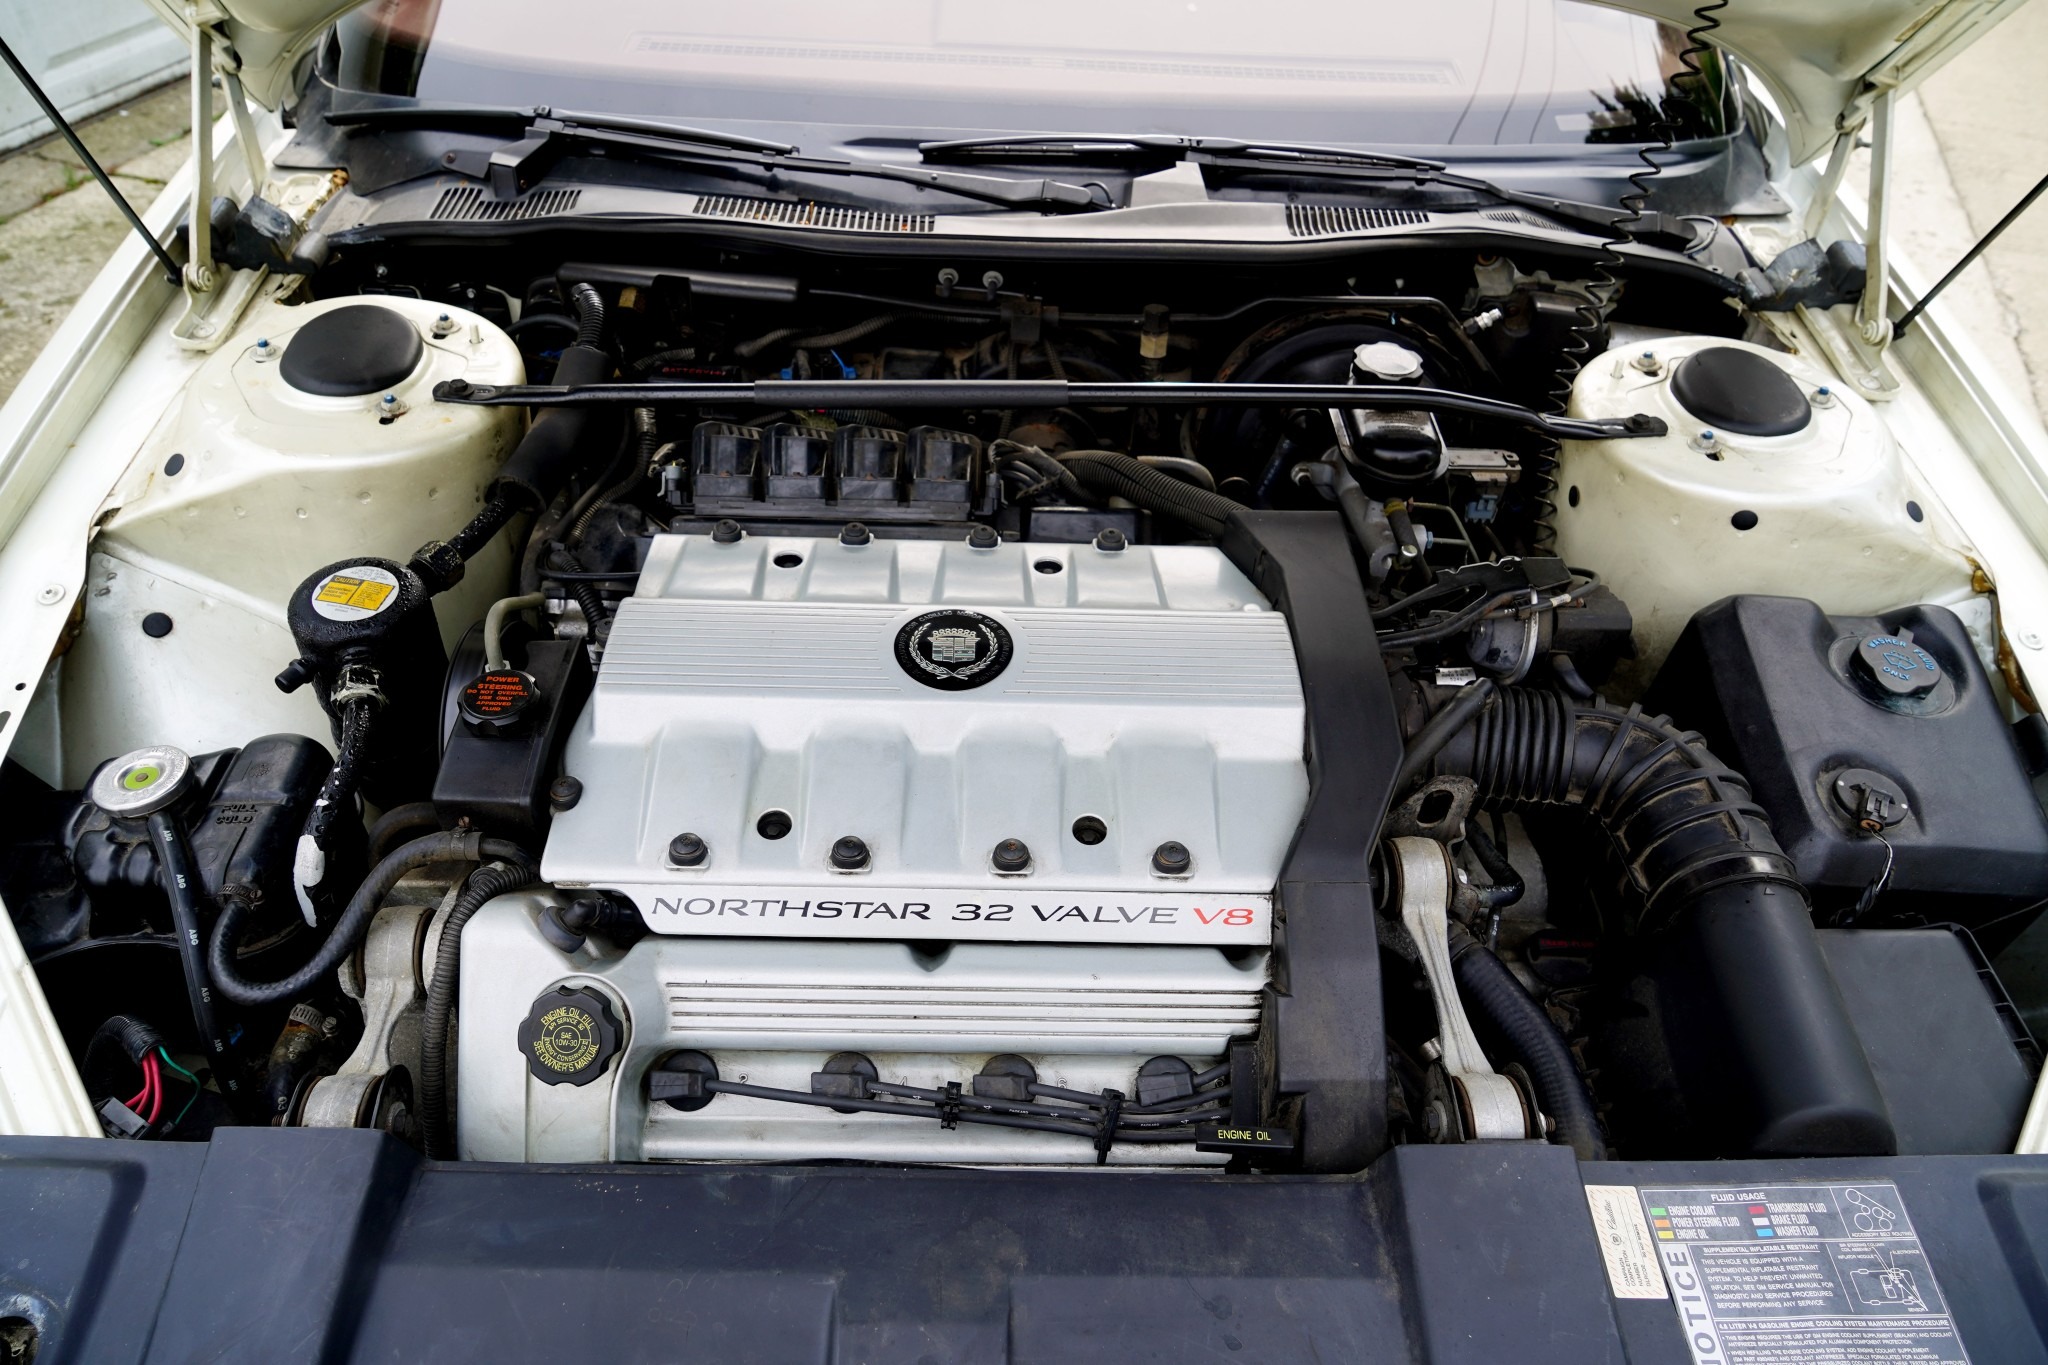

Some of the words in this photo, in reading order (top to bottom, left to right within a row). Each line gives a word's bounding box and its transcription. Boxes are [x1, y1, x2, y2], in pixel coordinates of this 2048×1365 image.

[334, 576, 361, 584] CAUTION
[919, 610, 952, 622] CADILLAC
[957, 610, 982, 620] MOTOR
[984, 618, 998, 628] CAR
[1867, 638, 1906, 648] WASHER
[1913, 648, 1935, 670] FLUID
[1882, 666, 1911, 680] ONLY
[176, 874, 186, 888] ABG
[652, 896, 932, 920] NORTHSTAR
[951, 903, 1014, 922] 32
[1030, 904, 1179, 924] VALVE
[1192, 908, 1254, 926] V8
[188, 929, 199, 945] ABG
[541, 1006, 567, 1025] ENGINE
[569, 1008, 580, 1019] OIL
[581, 1014, 594, 1030] FILL
[548, 1022, 557, 1030] API
[556, 1017, 578, 1025] SERVICE
[534, 1040, 545, 1056] SEE
[540, 1052, 574, 1072] OWNER'S
[575, 1044, 599, 1070] MANUAL
[544, 1038, 557, 1057] ENERGY
[557, 1045, 586, 1062] CONSERVING
[1217, 1130, 1252, 1140] ENGINE
[1256, 1131, 1272, 1141] OIL
[1737, 1192, 1766, 1201] USAGE
[1604, 1200, 1617, 1230] Cadillac
[1668, 1206, 1690, 1215] ENGINE
[1690, 1206, 1716, 1215] COOLANT
[1766, 1204, 1809, 1213] TRANSMISSION
[1809, 1203, 1827, 1212] FLUID
[1671, 1218, 1694, 1227] POWER
[1694, 1217, 1722, 1227] STEERING
[1722, 1217, 1740, 1226] FLUID
[1770, 1215, 1791, 1224] BRAKE
[1791, 1214, 1809, 1224] FLUID
[1675, 1229, 1697, 1239] ENGINE
[1698, 1229, 1709, 1238] OIL
[1774, 1226, 1799, 1236] WASHER
[1800, 1226, 1819, 1236] FLUID
[1619, 1257, 1630, 1287] CAMPAIGN
[1622, 1250, 1636, 1286] COMPLETION
[1633, 1263, 1643, 1286] NUMBER
